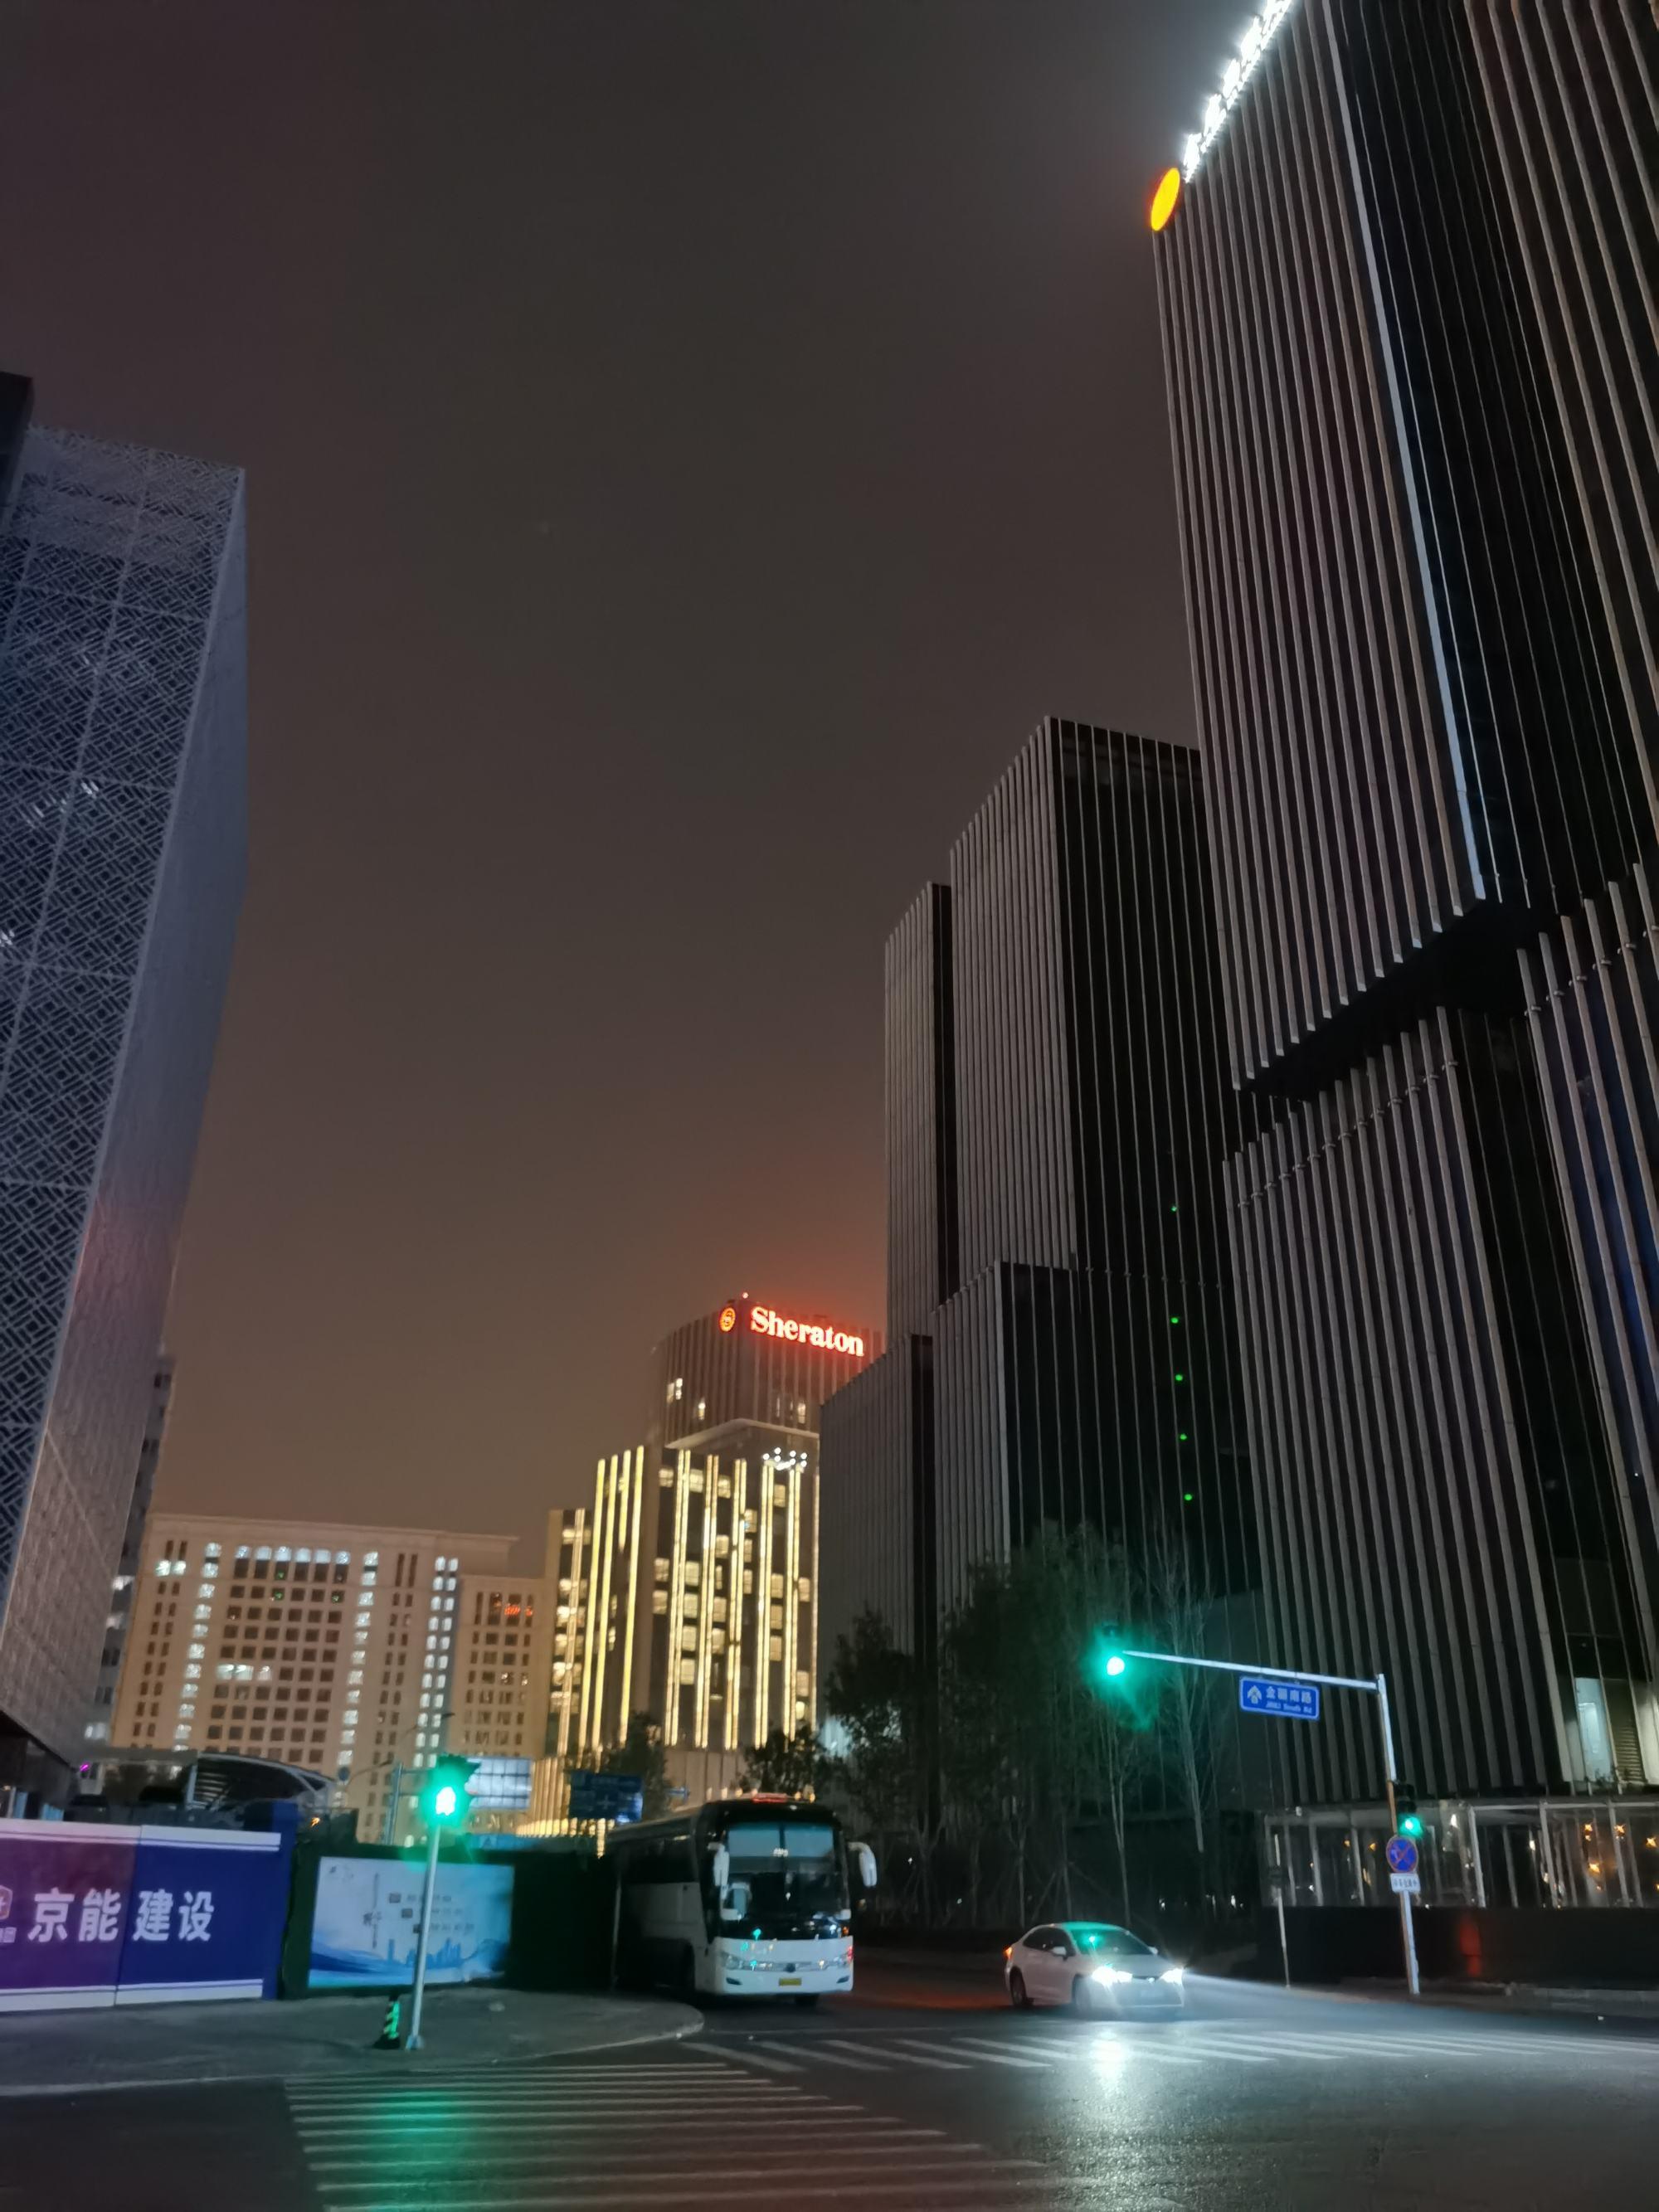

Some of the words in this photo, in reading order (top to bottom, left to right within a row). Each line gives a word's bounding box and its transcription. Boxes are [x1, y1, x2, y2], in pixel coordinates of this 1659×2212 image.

[751, 1306, 864, 1357] Sheraton
[27, 1887, 214, 1942] 京能建设
